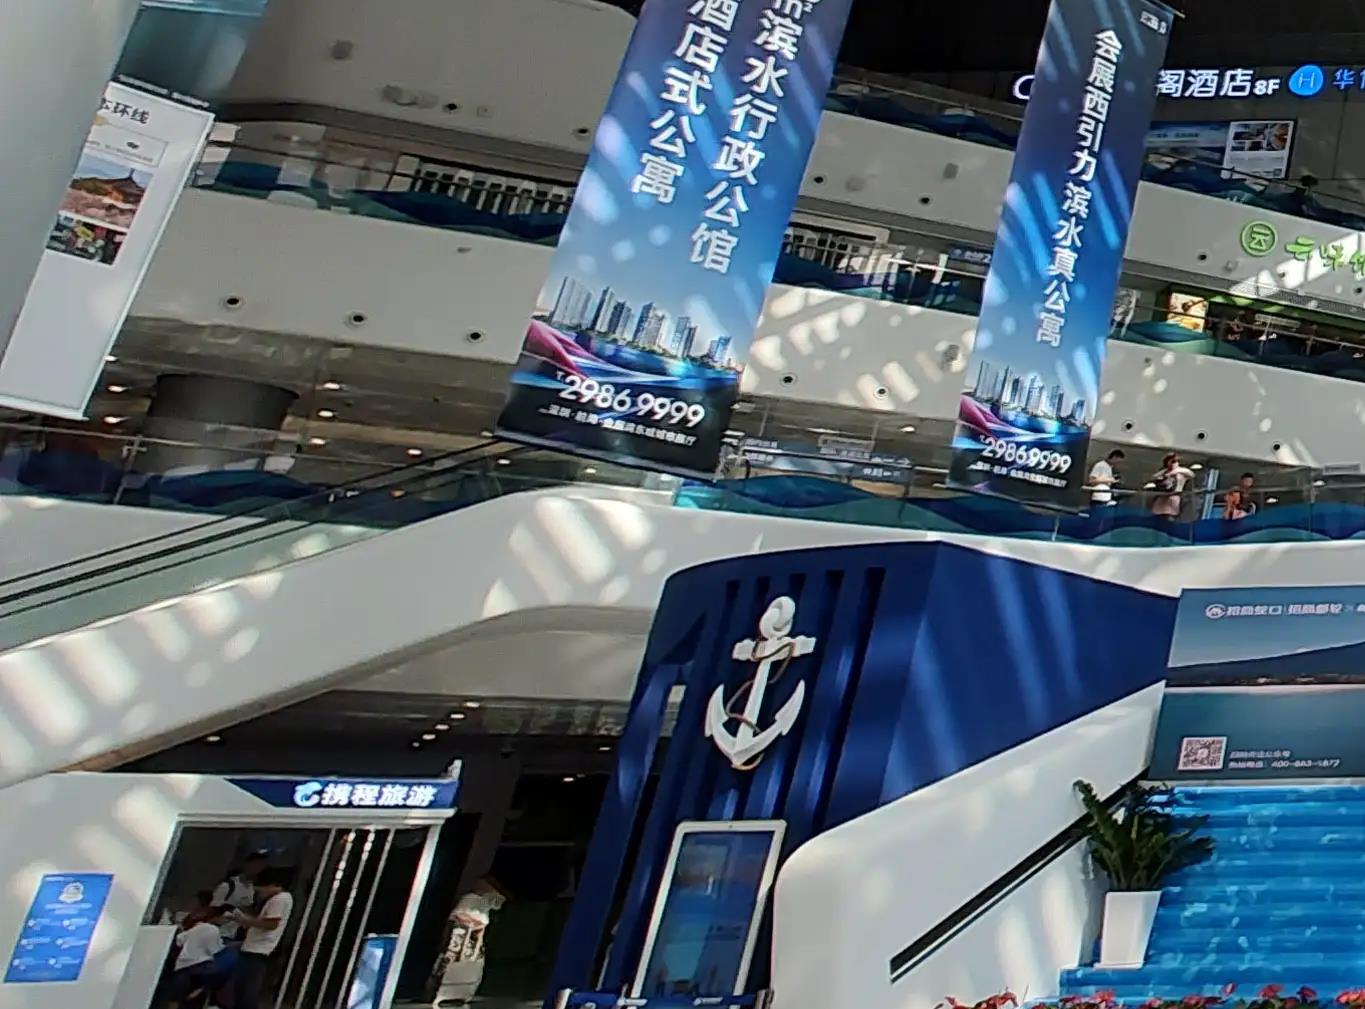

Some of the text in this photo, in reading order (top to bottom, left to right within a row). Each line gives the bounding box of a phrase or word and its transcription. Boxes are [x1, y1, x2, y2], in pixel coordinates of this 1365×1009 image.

[1253, 78, 1281, 96] 8F
[320, 783, 438, 807] 携程旅游
